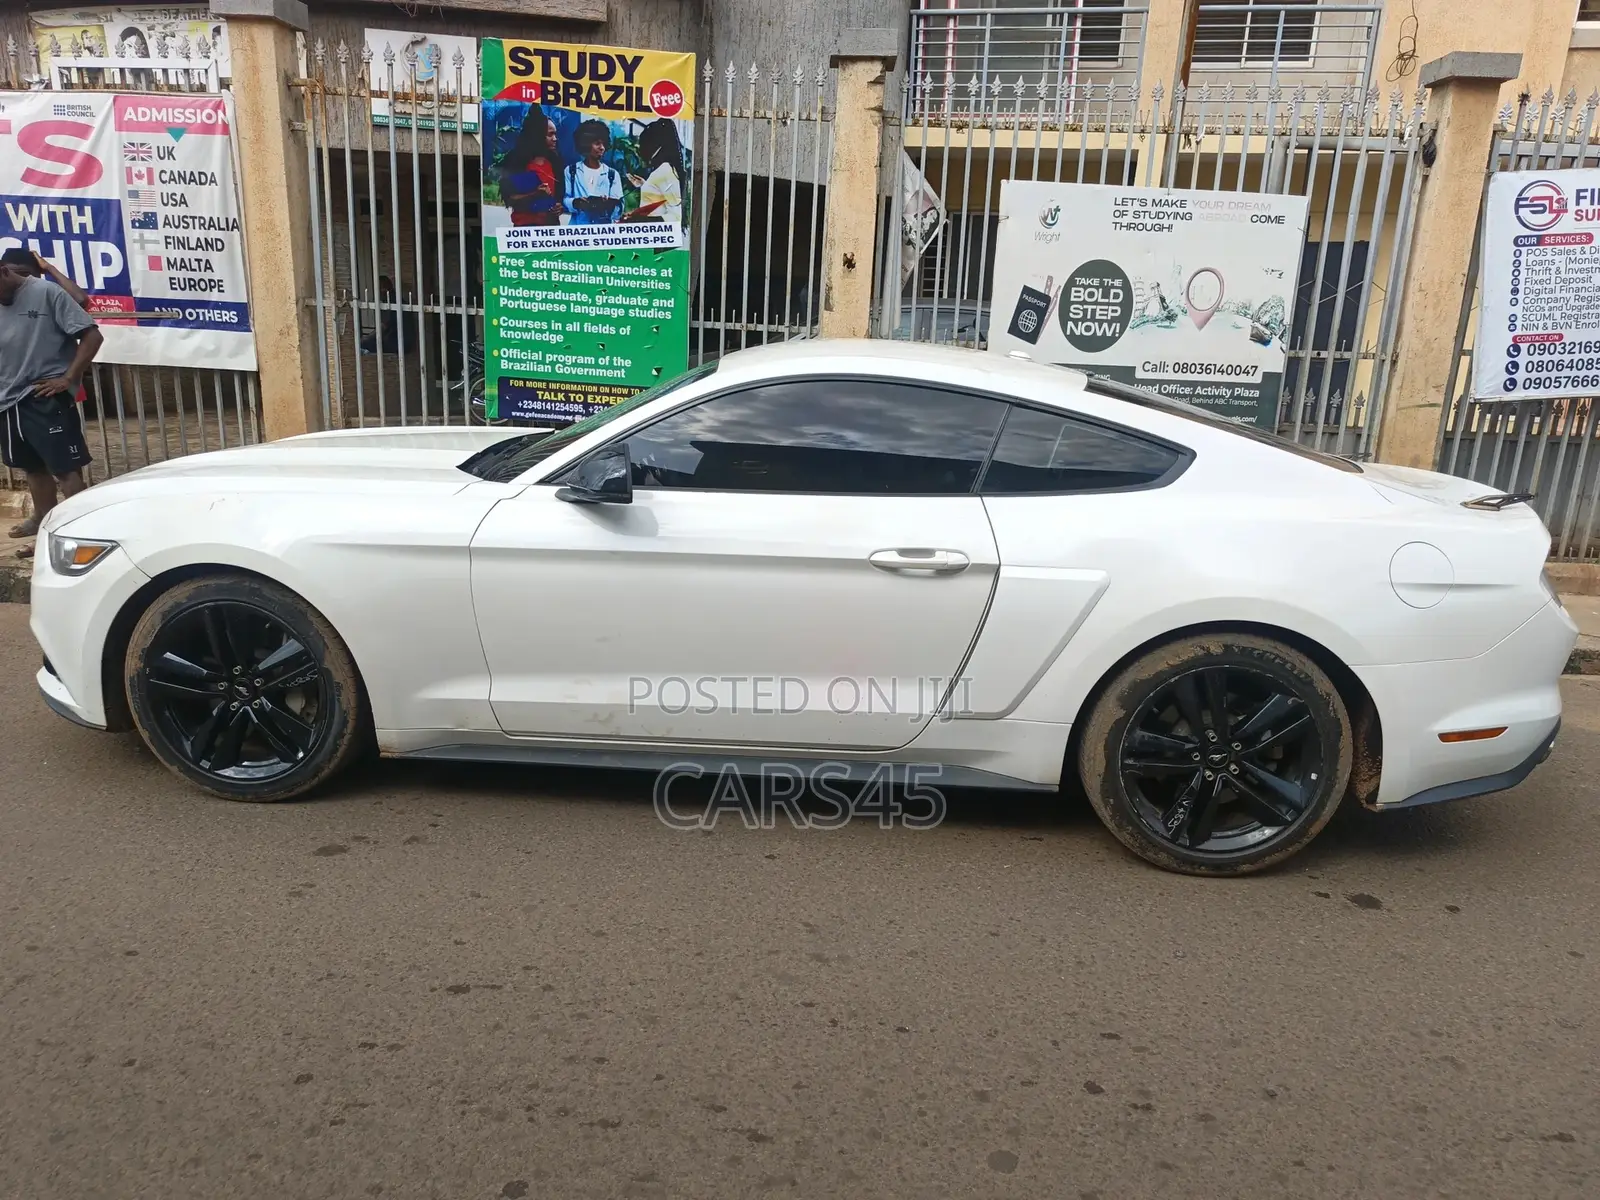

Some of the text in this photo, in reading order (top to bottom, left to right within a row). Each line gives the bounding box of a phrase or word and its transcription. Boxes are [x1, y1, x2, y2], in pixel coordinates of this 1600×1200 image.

[508, 46, 644, 84] STUDY
[522, 79, 653, 113] in BRAZIL
[651, 91, 682, 108] Free
[123, 106, 229, 125] ADMISSION
[156, 145, 176, 161] UK
[158, 169, 218, 187] CANADA
[160, 192, 189, 208] USA
[1113, 197, 1272, 212] LET'S MAKE YOUR DREAM
[5, 202, 94, 234] WITH
[162, 214, 240, 232] AUSTRALIA
[1112, 209, 1129, 219] OF
[1132, 210, 1193, 221] STUDYING
[1250, 214, 1286, 225] COME
[505, 224, 674, 238] JOIN THE BRAZILIAN PROGRAM
[1112, 222, 1174, 233] THROUGH!
[164, 235, 225, 252] FINLAND
[507, 235, 675, 249] FOR EXCHANGE STUDENTS-PEC
[1034, 231, 1061, 244] Wright
[1517, 235, 1590, 245] OUR SERVICES:
[1526, 248, 1548, 258] POS
[1550, 247, 1577, 257] Sales
[1579, 246, 1587, 255] &
[0, 236, 124, 290] HIP
[166, 257, 214, 273] MALTA
[499, 255, 673, 278] Free admission vacancies at
[1525, 258, 1556, 267] Loans
[499, 267, 672, 291] the best Brazilian Universities
[1524, 267, 1552, 277] Thrift
[1554, 266, 1562, 276] &
[169, 276, 225, 293] EUROPE
[1074, 277, 1123, 287] TAKE THE
[1524, 275, 1593, 286] Fixed Deposit
[499, 285, 675, 308] Undergraduate, graduate and
[1070, 287, 1124, 303] BOLD
[1523, 285, 1557, 297] Digital
[499, 297, 673, 320] Portuguese language studies
[1022, 293, 1047, 308] PASSPORT
[1522, 295, 1572, 306] Company
[1522, 305, 1546, 313] NGOs
[1547, 303, 1564, 312] and
[185, 308, 238, 323] OTHERS
[1069, 304, 1121, 320] STEP
[1521, 313, 1558, 323] SCUML
[499, 316, 632, 336] Courses in all fields of
[1066, 321, 1120, 337] NOW!
[1521, 322, 1540, 332] NIN
[1541, 322, 1549, 331] &
[1551, 320, 1573, 331] BVN
[499, 327, 565, 344] knowledge
[1526, 340, 1600, 357] 09032169
[500, 347, 633, 368] Official program of the
[500, 359, 627, 379] Brazilian Government
[1142, 360, 1259, 377] Call: 08036140047
[509, 379, 525, 388] FOR
[525, 381, 548, 389] MORE
[549, 383, 599, 393] INFORMATION
[599, 386, 611, 394] ON
[611, 387, 629, 395] HOW
[1522, 374, 1600, 391] 09057666
[536, 390, 567, 402] TALK
[568, 393, 585, 403] TO
[1161, 384, 1193, 394] Office:
[1194, 386, 1232, 398] Activity
[1234, 387, 1260, 398] Plaza
[517, 400, 587, 415] +2348141254595,
[1192, 397, 1214, 405] Behind
[1228, 399, 1259, 407] Transport,
